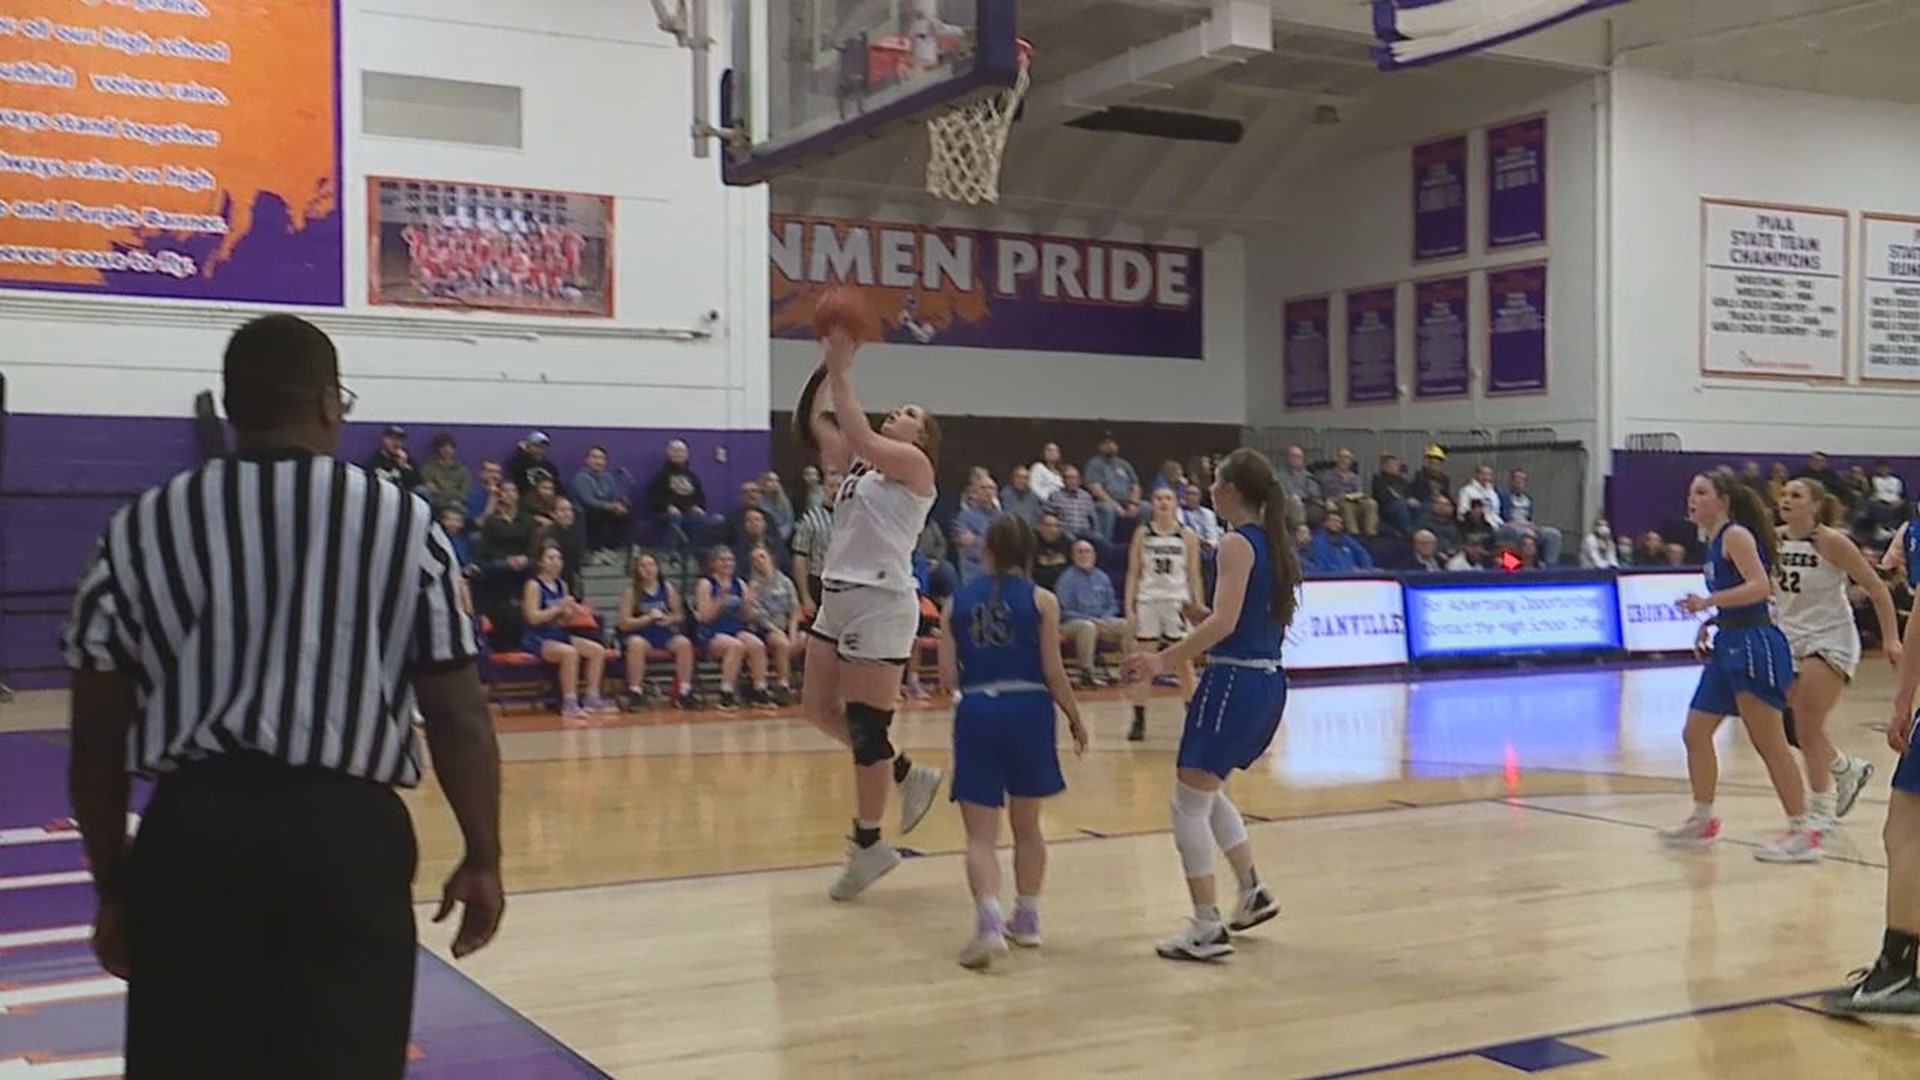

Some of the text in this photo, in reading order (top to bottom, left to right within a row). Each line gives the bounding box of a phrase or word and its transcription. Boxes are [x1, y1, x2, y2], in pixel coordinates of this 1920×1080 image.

[156, 37, 231, 64] school
[89, 73, 164, 98] voices
[51, 112, 118, 137] stand
[120, 119, 220, 146] together
[60, 199, 141, 229] Purple
[1731, 230, 1775, 249] STATE
[997, 238, 1190, 306] PRIDE
[1729, 248, 1821, 270] CHAMPIONS
[1779, 571, 1801, 594] 22
